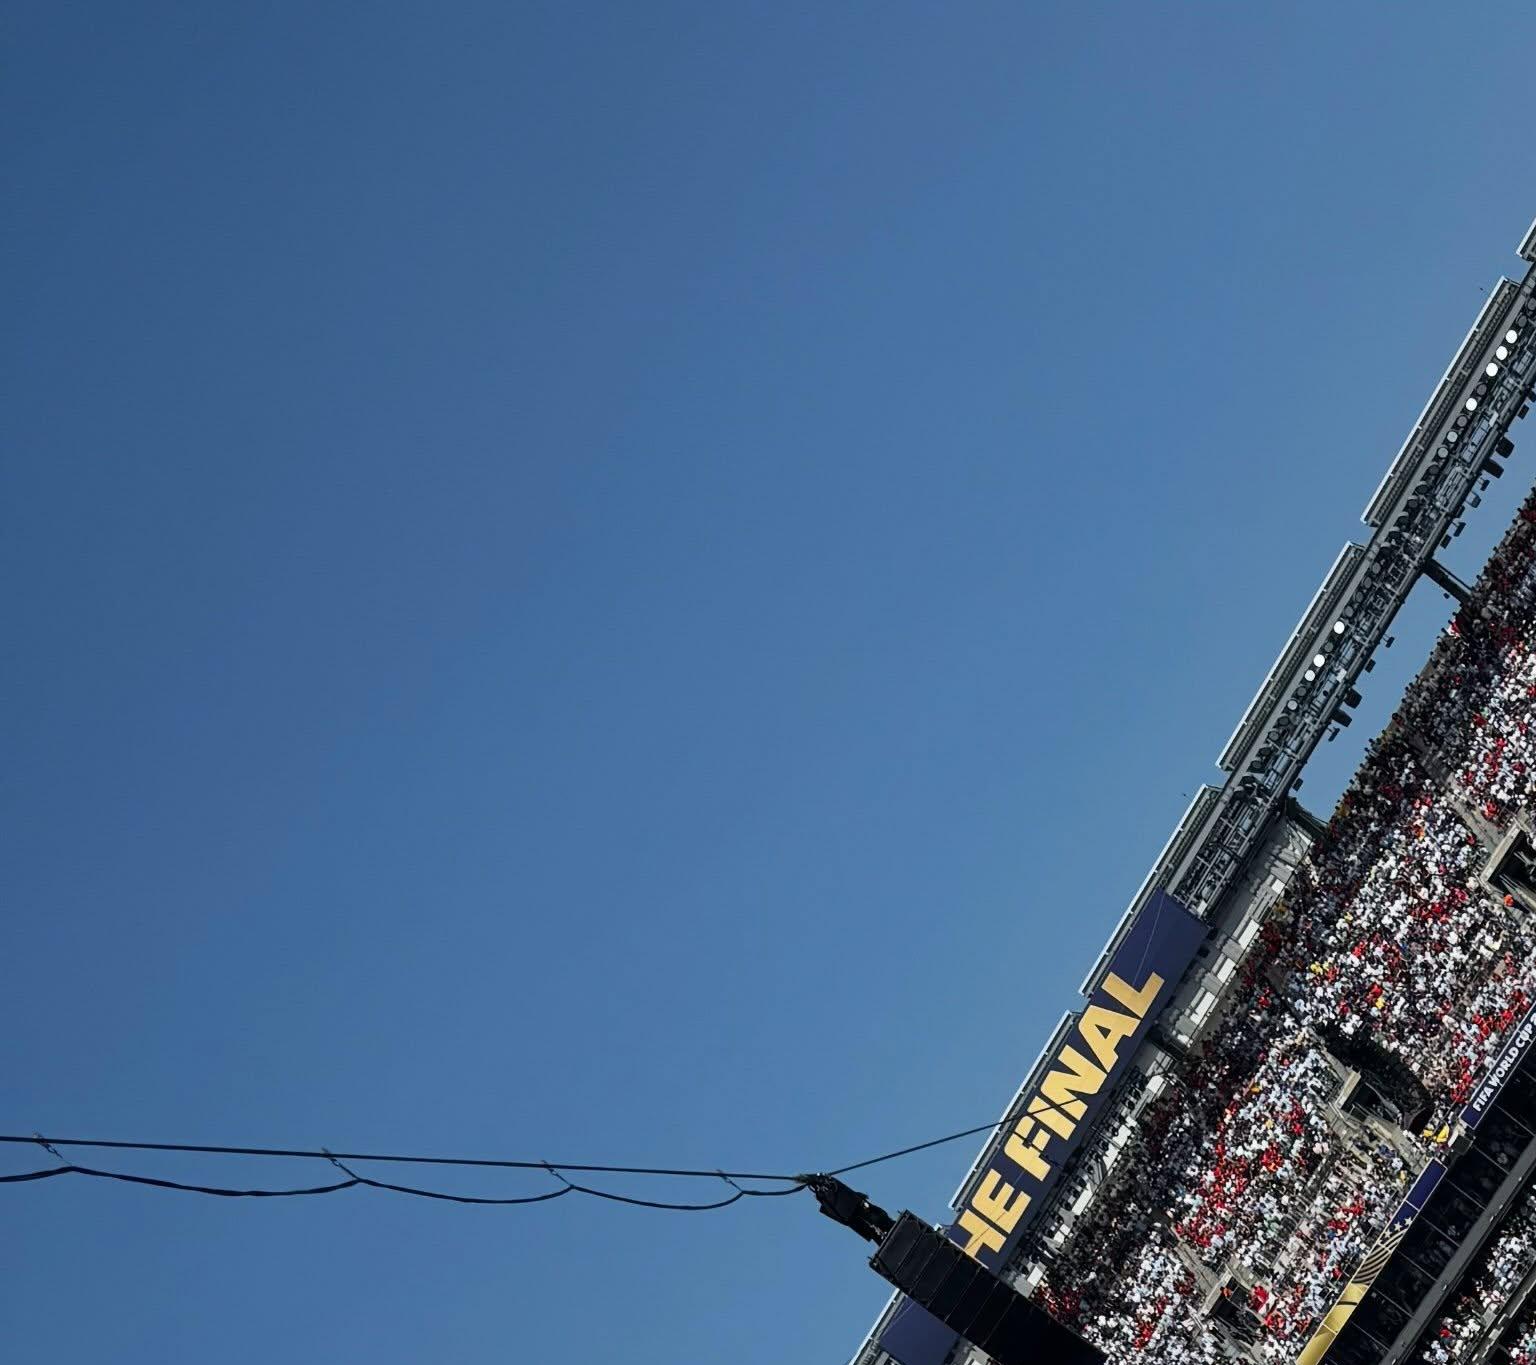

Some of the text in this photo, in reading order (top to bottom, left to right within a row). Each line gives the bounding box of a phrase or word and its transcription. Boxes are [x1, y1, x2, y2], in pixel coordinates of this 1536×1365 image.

[945, 969, 1168, 1270] HE FINAL
[1471, 1083, 1496, 1113] FIFA
[1488, 1046, 1521, 1088] WORLD
[1513, 1023, 1536, 1050] CUP
